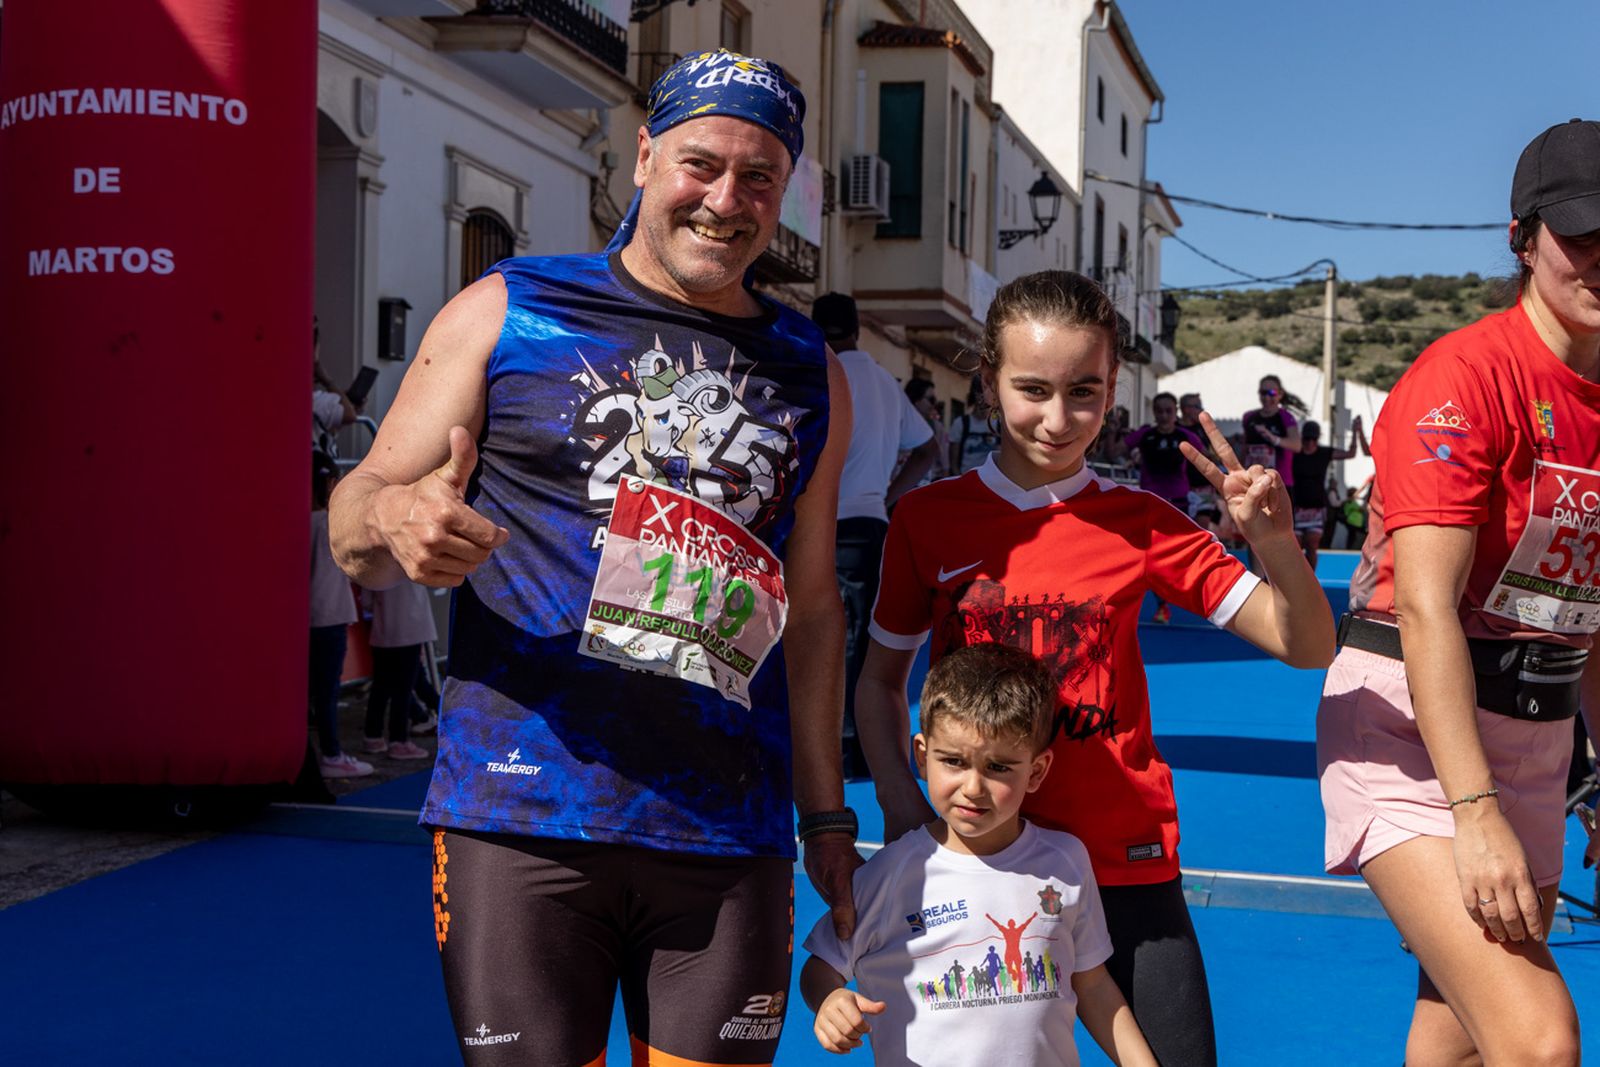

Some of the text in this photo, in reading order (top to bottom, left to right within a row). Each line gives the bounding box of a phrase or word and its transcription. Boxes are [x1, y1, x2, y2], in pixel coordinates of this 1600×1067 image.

[1, 88, 248, 129] AYUNTAMIENTO
[73, 167, 121, 193] DE
[28, 246, 175, 276] MARTOS
[1555, 474, 1579, 508] X
[643, 494, 679, 533] X
[643, 553, 755, 639] 119
[1503, 573, 1553, 594] CRISTINA
[593, 604, 699, 640] JUAN REPULL
[486, 762, 542, 776] TEAMERGY
[923, 899, 968, 919] REALE
[926, 911, 969, 929] SEGUROS
[934, 1001, 961, 1010] CARRERA
[962, 997, 998, 1008] NOCTURNA
[999, 994, 1023, 1005] PRIEGO
[464, 1031, 521, 1046] TEAMERGY
